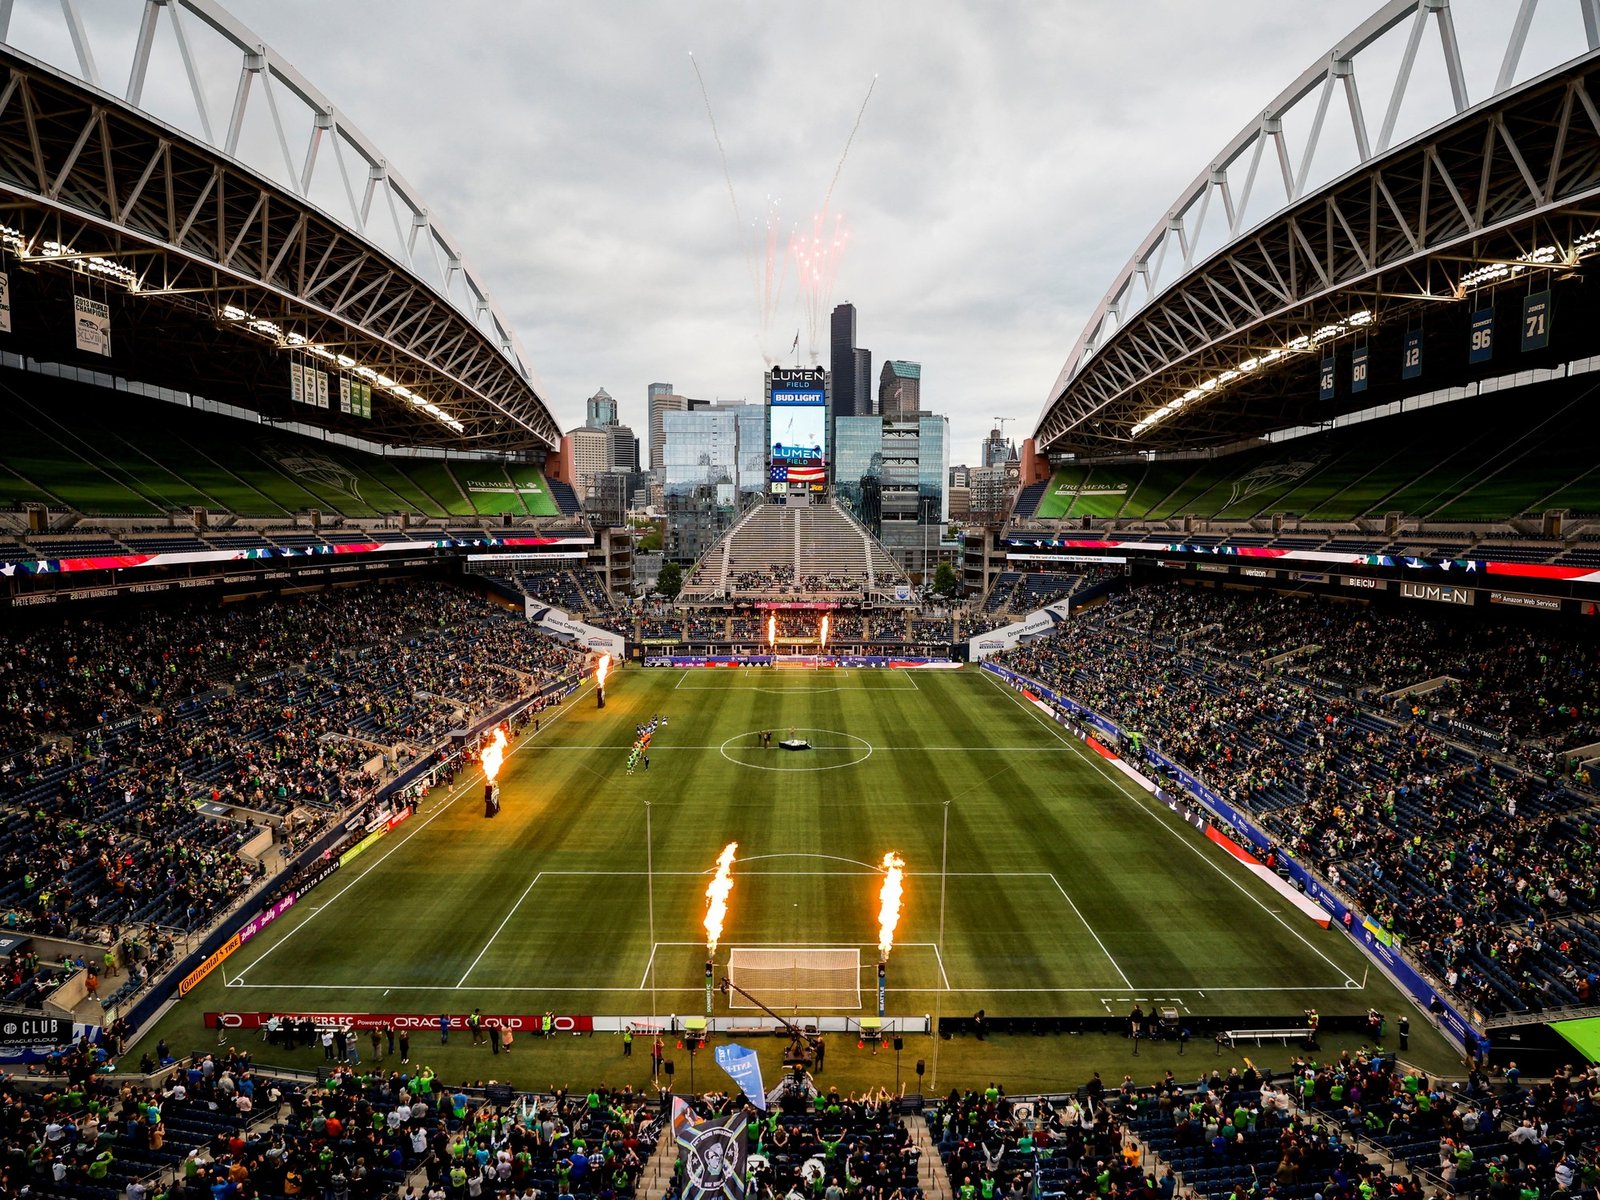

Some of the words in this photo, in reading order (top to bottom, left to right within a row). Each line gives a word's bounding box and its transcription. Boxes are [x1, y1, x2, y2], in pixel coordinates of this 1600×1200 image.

[76, 304, 108, 318] CHAMPIONS
[89, 301, 107, 312] WORLD
[1528, 304, 1545, 312] JONES
[1526, 314, 1544, 338] 71
[1472, 329, 1491, 350] 96
[1406, 348, 1419, 367] 12
[772, 372, 824, 380] LUMEN
[1354, 364, 1366, 381] 80
[1321, 374, 1333, 390] 45
[773, 448, 821, 459] LUMEN
[1245, 569, 1266, 577] verizon
[1404, 584, 1467, 603] LUMEN
[16, 598, 28, 606] PETE
[29, 597, 46, 605] GROSS
[1503, 596, 1522, 604] Amazon
[1524, 597, 1535, 606] Web
[1536, 600, 1558, 608] Services
[547, 617, 563, 626] Insure
[564, 623, 586, 635] Carefully
[1007, 628, 1024, 638] Dream
[1025, 619, 1050, 631] Fearlessly
[1454, 721, 1473, 731] DELTA
[323, 861, 339, 877] DELTA
[300, 878, 318, 894] DELTA
[181, 955, 219, 994] Continental
[224, 939, 239, 956] TIRE
[22, 1020, 58, 1035] CLUB
[338, 1017, 353, 1026] FC
